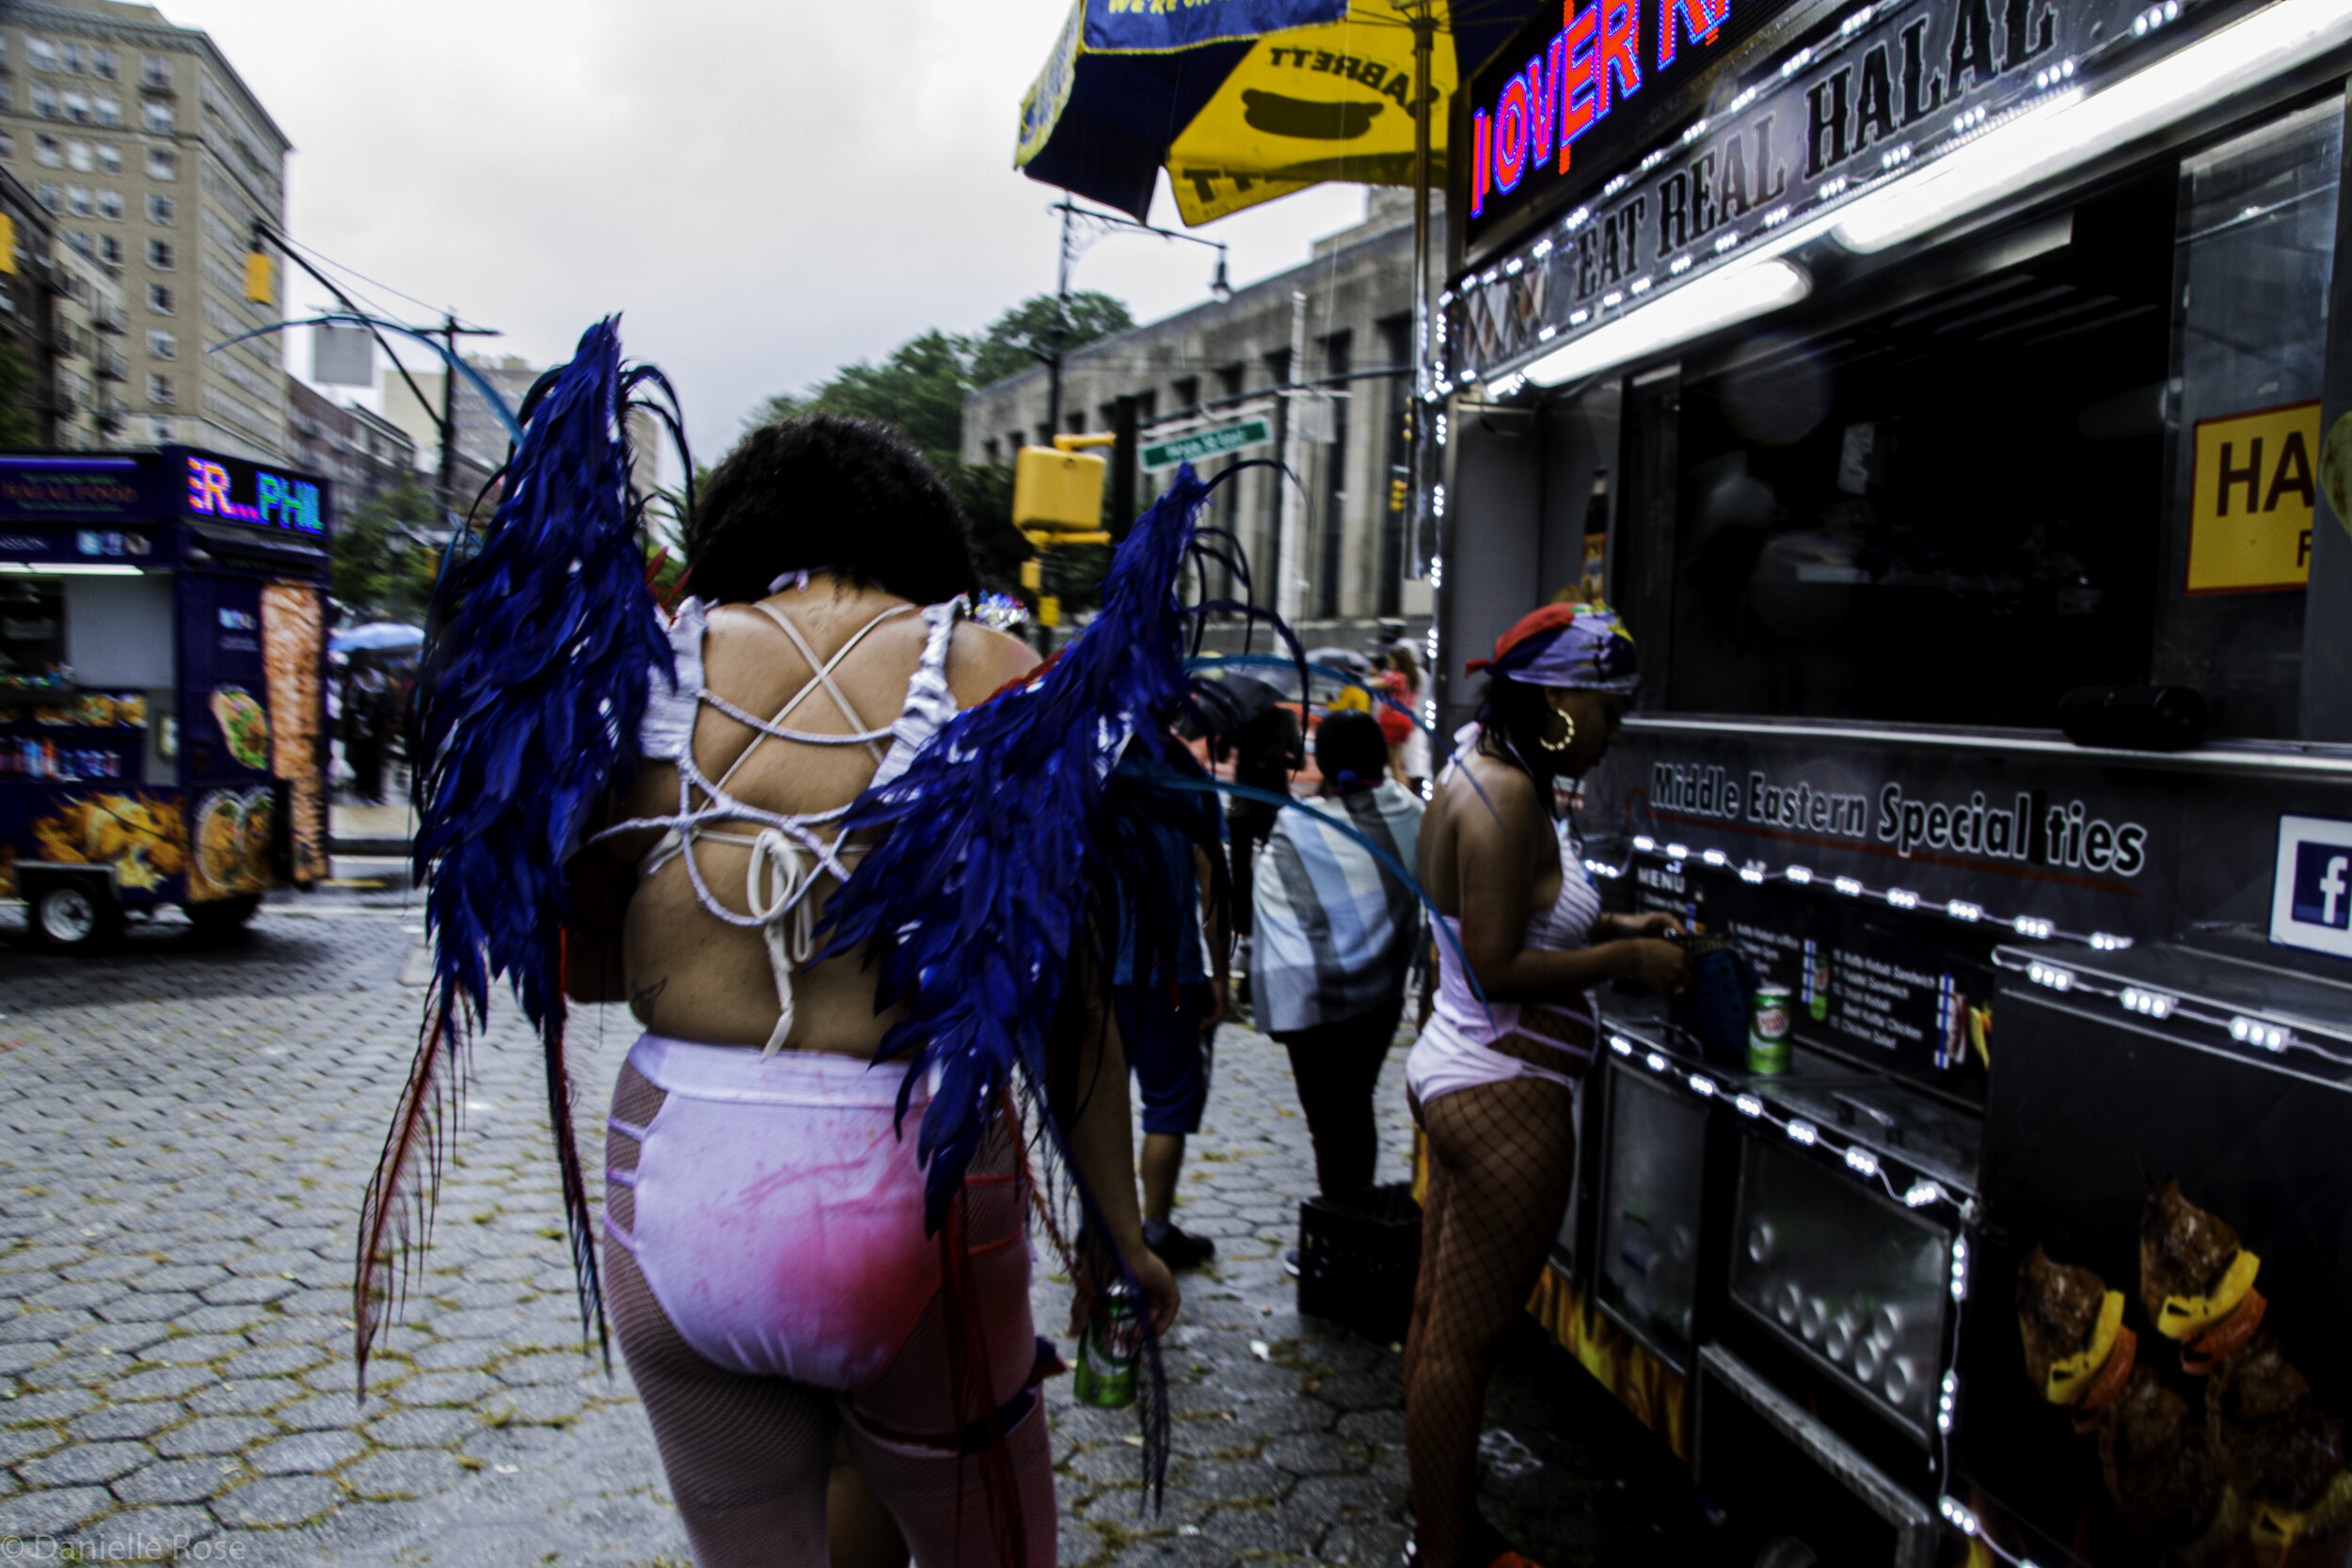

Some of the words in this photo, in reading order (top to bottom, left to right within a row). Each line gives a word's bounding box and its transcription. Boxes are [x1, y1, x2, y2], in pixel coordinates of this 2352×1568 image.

[1575, 195, 1646, 304] EAT
[1656, 115, 1786, 261] REAL
[1801, 0, 2060, 182] HALAL
[1650, 760, 1740, 820] Middle
[1746, 770, 1867, 836] Eastern
[1637, 865, 1687, 895] MENU
